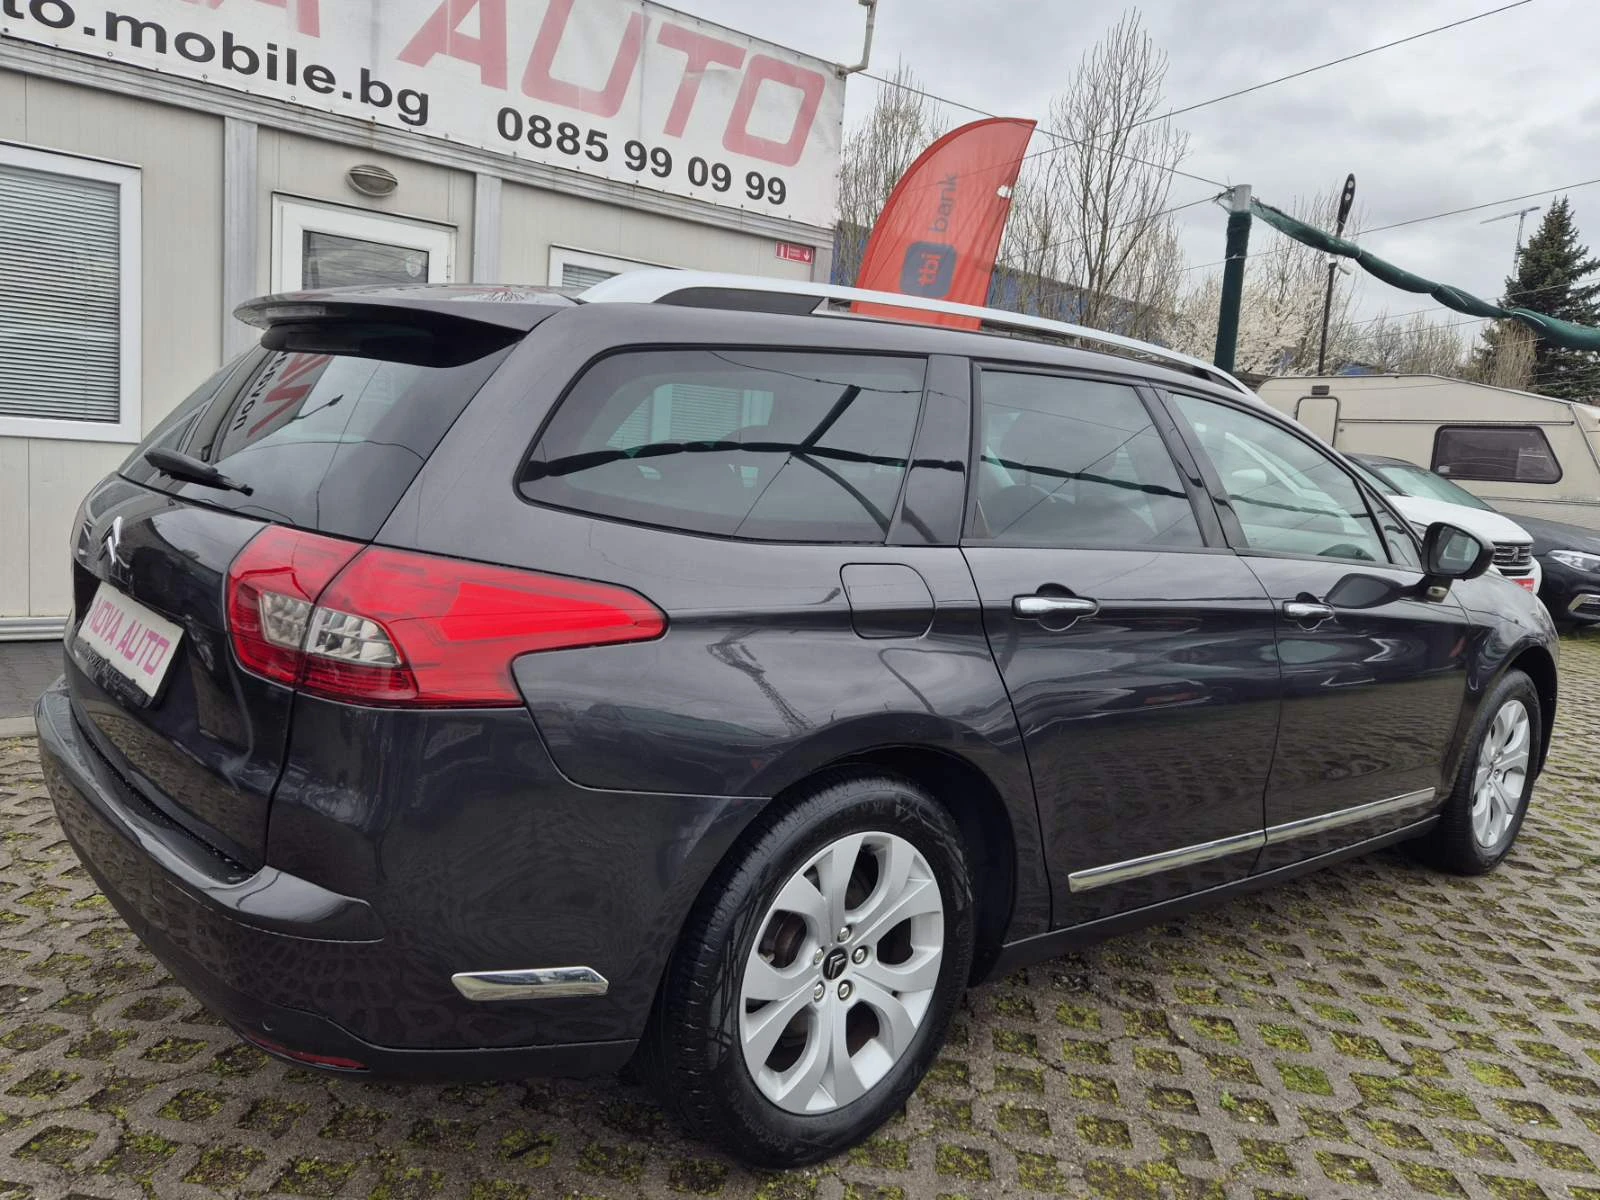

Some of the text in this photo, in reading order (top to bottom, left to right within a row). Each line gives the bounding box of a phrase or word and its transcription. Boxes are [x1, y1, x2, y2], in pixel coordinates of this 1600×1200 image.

[399, 0, 826, 167] AUTO
[497, 107, 787, 205] 0885 99 09 99
[917, 172, 960, 288] tbi bank
[115, 618, 170, 676] AUTO
